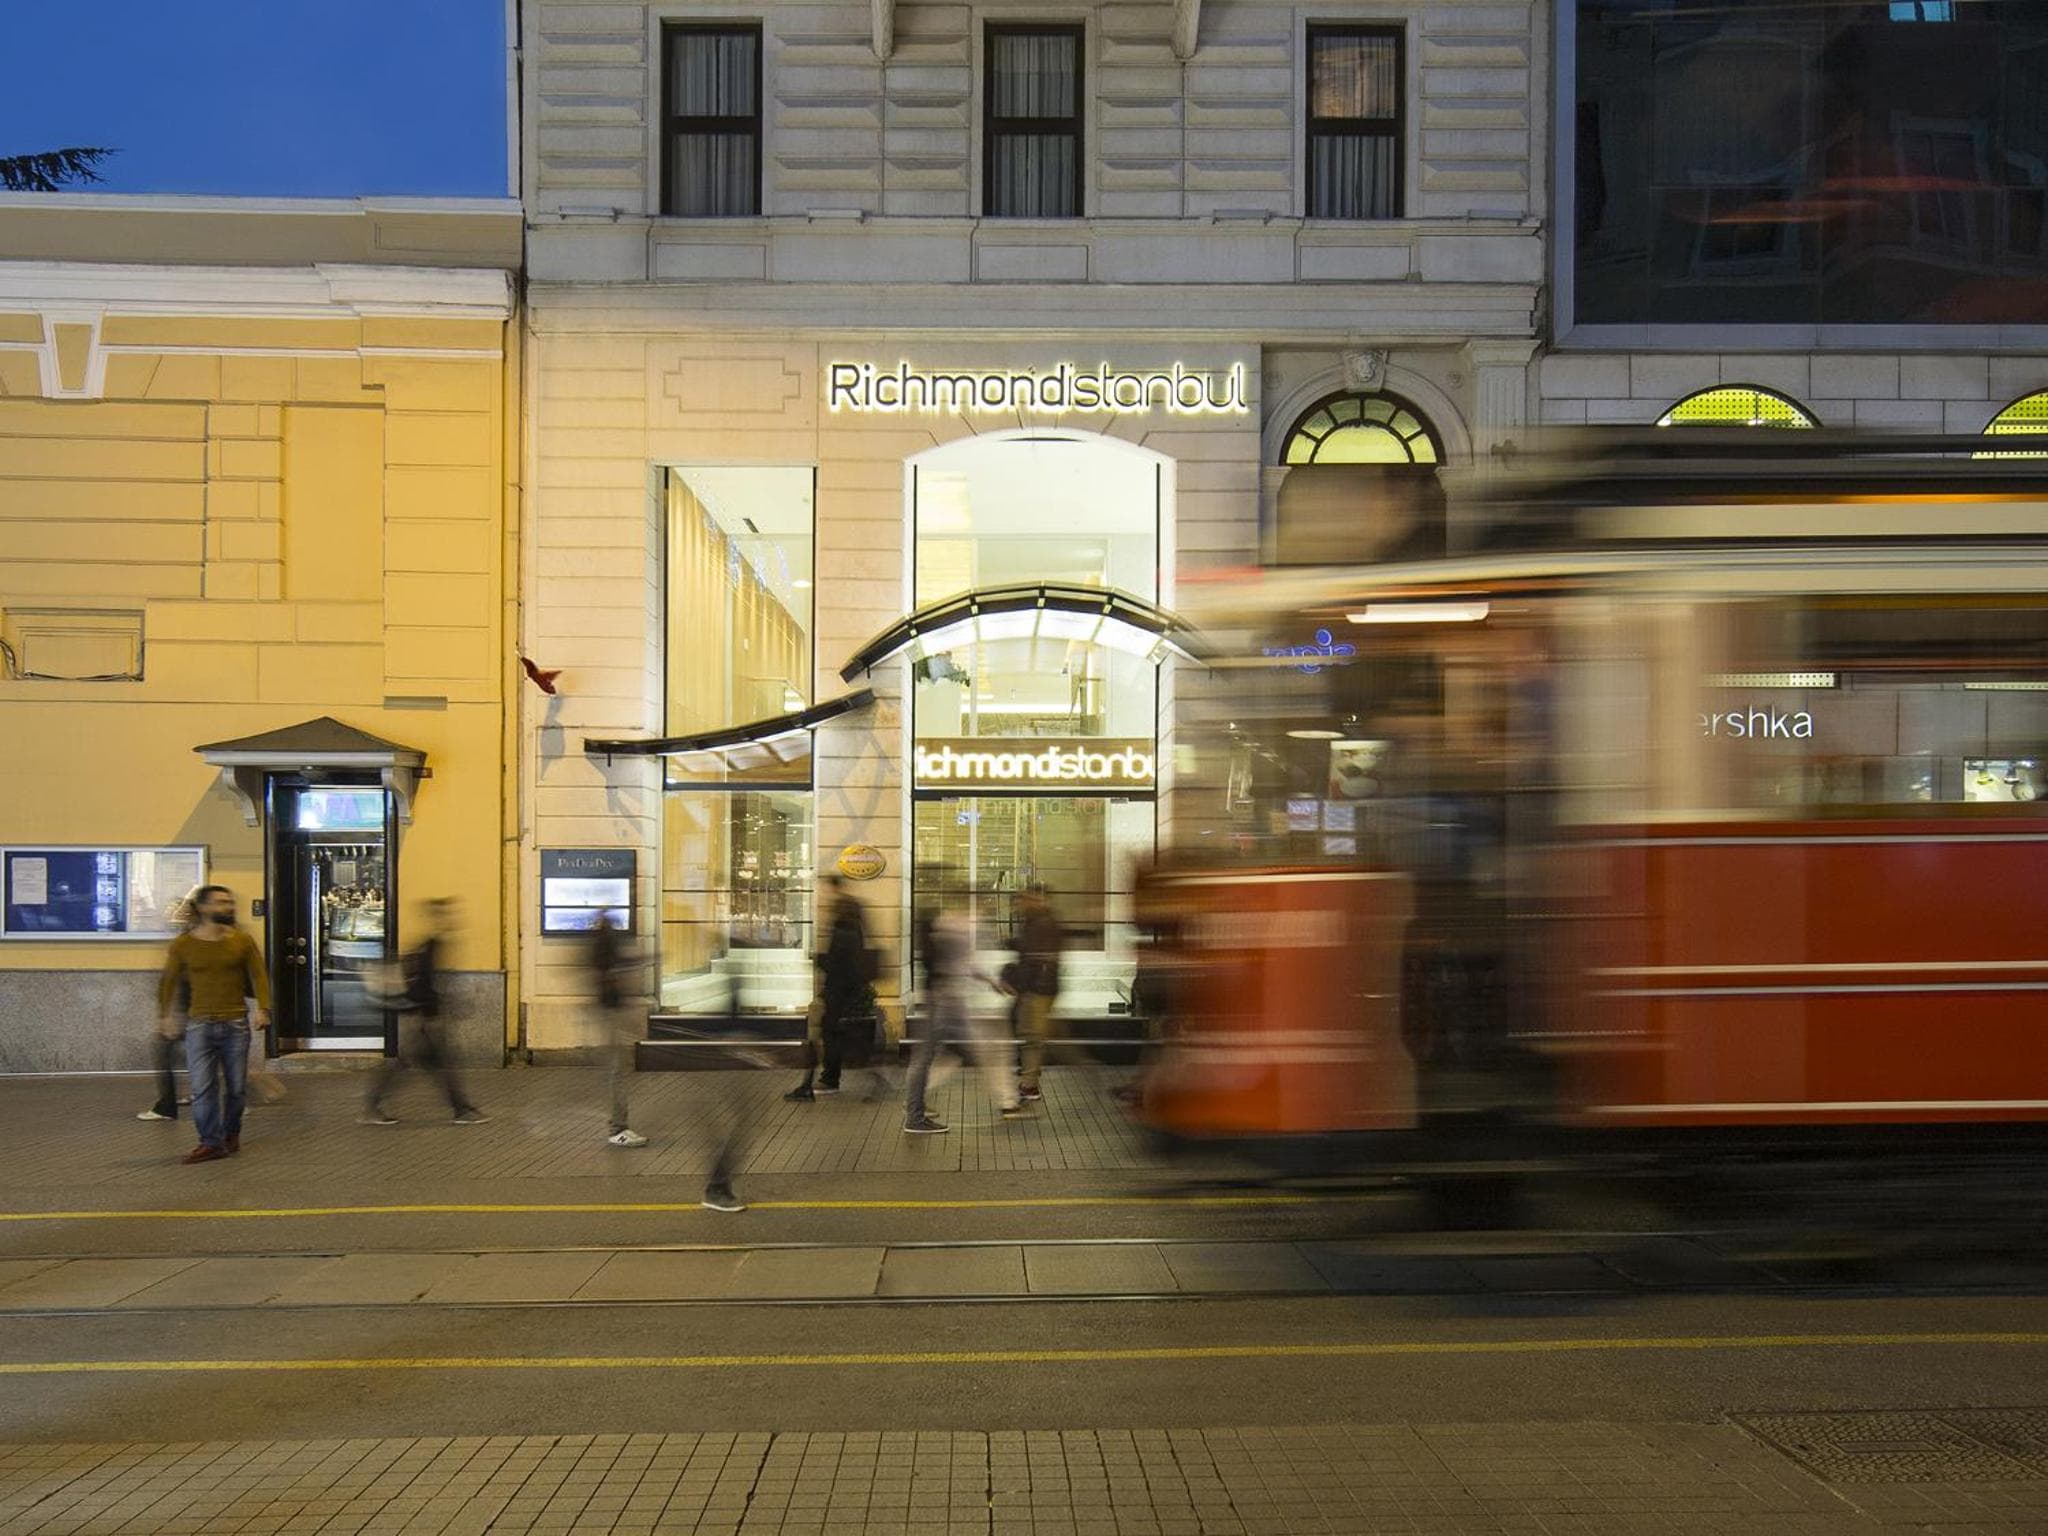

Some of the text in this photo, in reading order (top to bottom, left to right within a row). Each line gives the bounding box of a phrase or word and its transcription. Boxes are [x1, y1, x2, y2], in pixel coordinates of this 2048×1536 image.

[830, 362, 1248, 410] Richmondistanbul
[1696, 704, 1813, 738] ershka
[915, 744, 1155, 779] ichmondistanb
